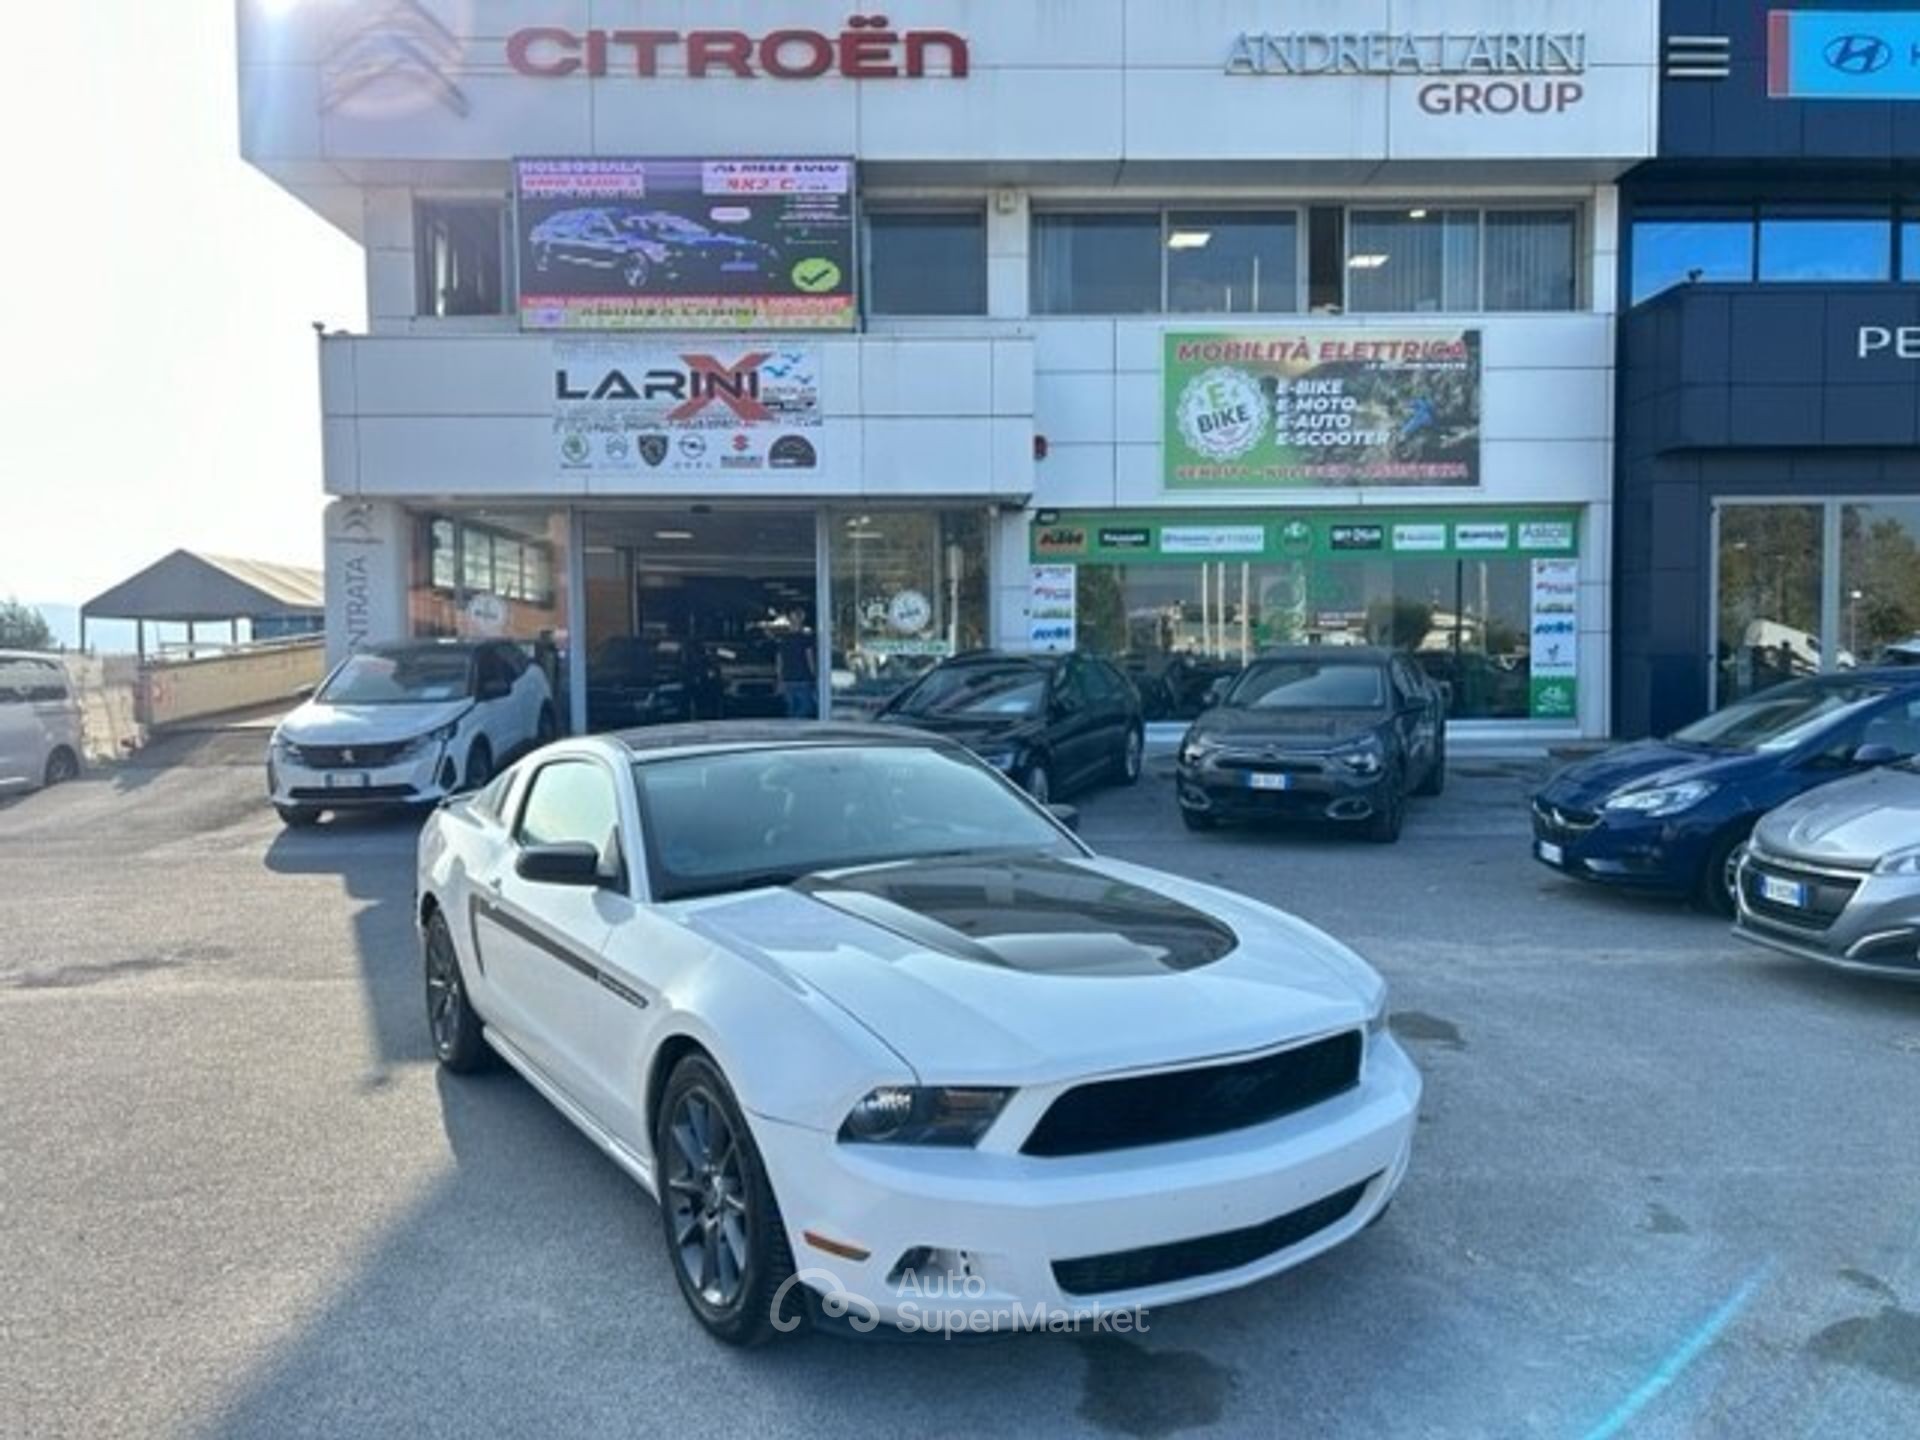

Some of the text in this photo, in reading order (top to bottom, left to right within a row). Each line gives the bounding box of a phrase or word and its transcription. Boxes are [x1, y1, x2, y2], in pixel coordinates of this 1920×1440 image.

[1224, 31, 1586, 76] ANDREA LARINI
[1418, 81, 1584, 115] GROUP
[1177, 336, 1468, 362] MOBILITÀ ELETTRICA
[555, 368, 760, 401] LARINI
[1275, 378, 1344, 395] E-BIKE
[1275, 396, 1357, 413] E-MOTO
[1196, 404, 1250, 434] BIKE
[1275, 413, 1352, 430] E-AUTO
[1275, 431, 1391, 446] E-SCOOTER
[346, 554, 368, 652] NTRATA
